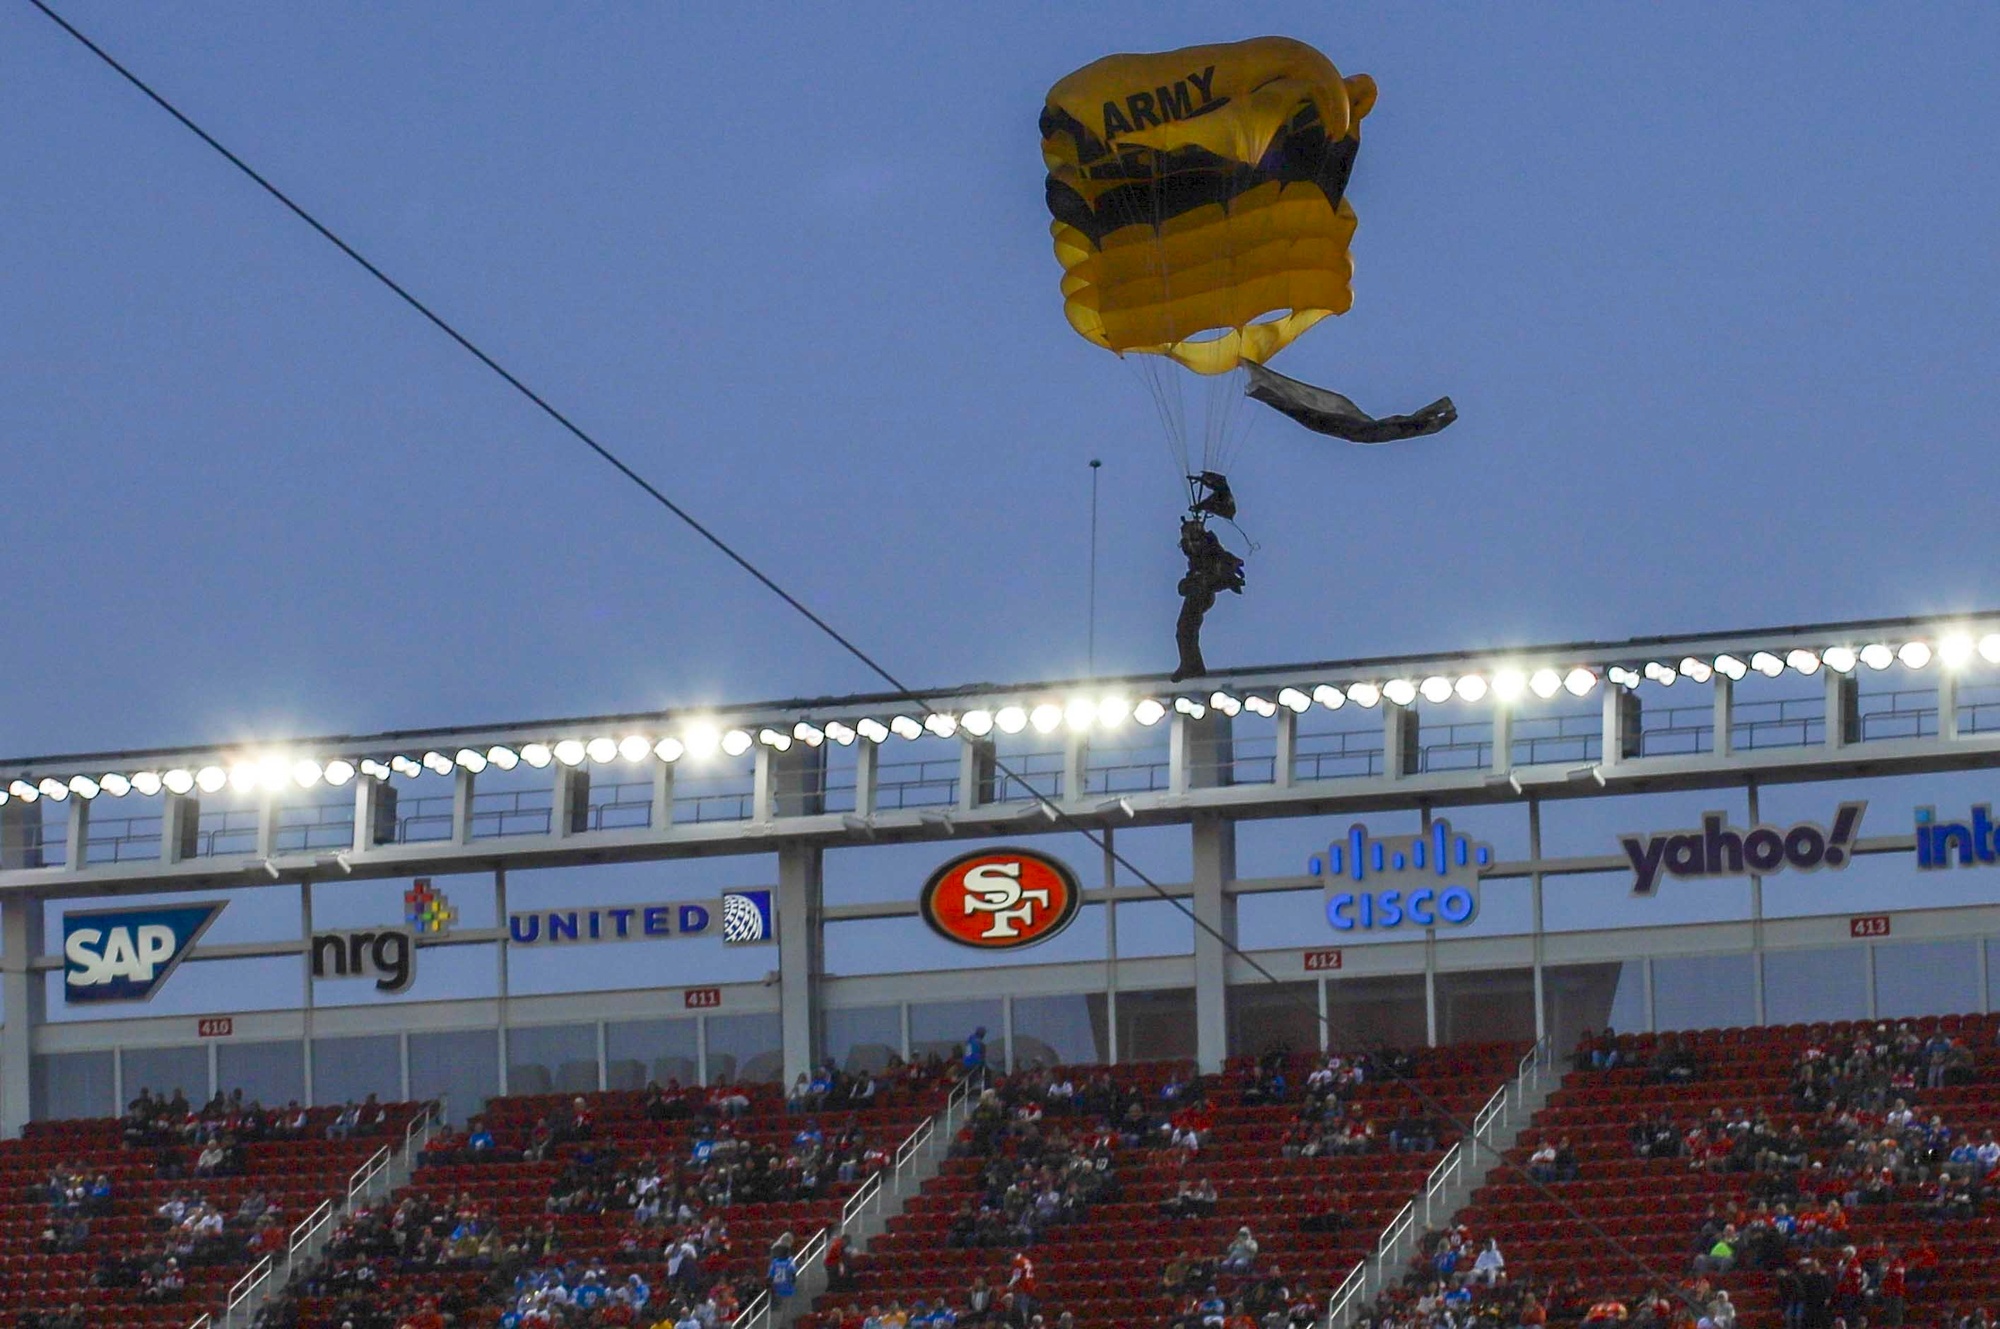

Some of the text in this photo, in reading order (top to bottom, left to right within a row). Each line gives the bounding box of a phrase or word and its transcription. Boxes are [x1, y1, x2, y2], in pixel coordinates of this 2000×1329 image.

[1103, 65, 1215, 139] ARMY
[1622, 806, 1858, 892] yahoo!
[1915, 807, 2000, 867] int
[509, 905, 709, 943] UNITED
[1326, 886, 1473, 930] CISCO
[1854, 918, 1887, 935] 413
[65, 924, 175, 987] SAP
[312, 931, 410, 990] nrg
[1308, 953, 1338, 968] 412
[688, 990, 718, 1006] 411
[202, 1020, 229, 1036] 410
